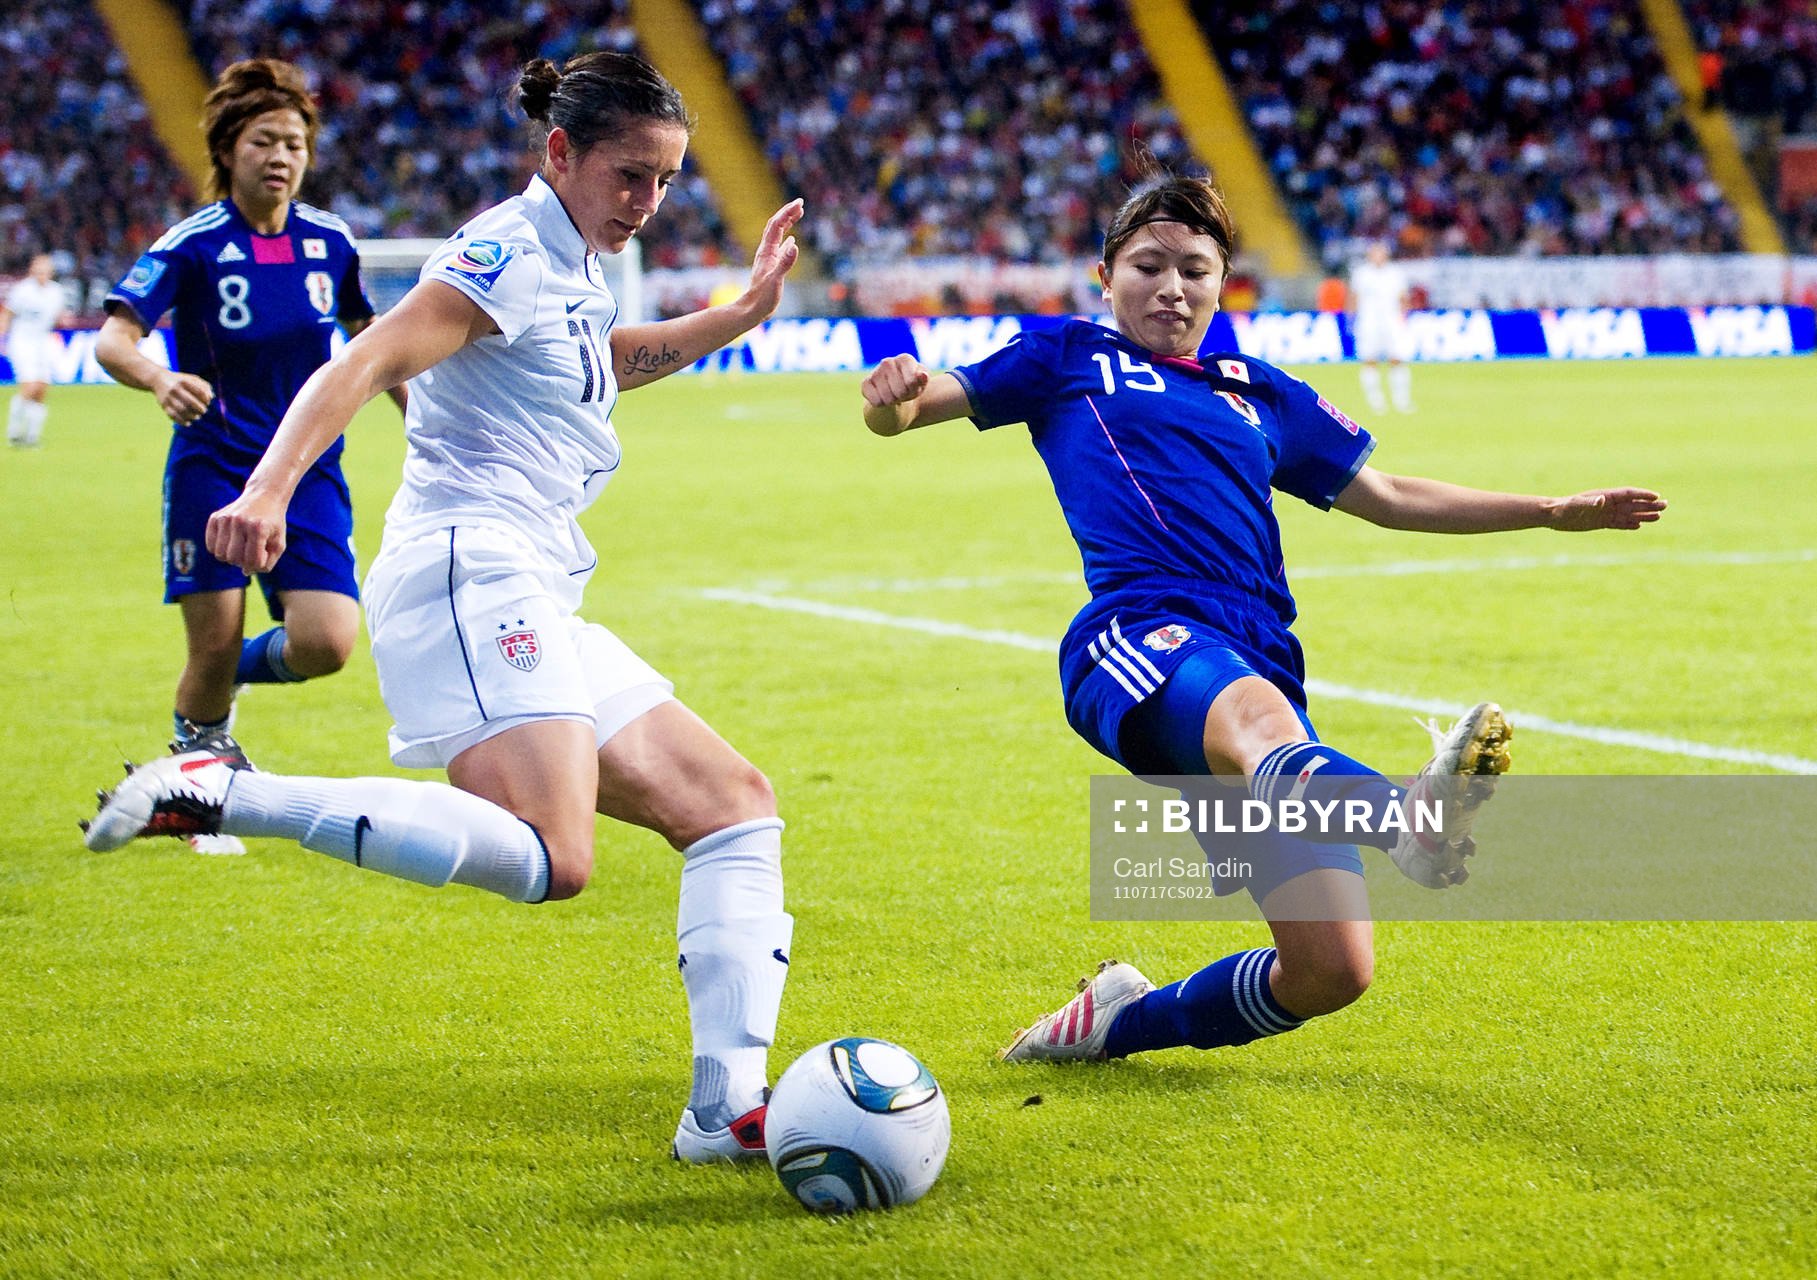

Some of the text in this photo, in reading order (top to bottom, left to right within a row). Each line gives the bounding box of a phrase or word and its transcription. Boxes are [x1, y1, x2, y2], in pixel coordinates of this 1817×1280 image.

[217, 274, 251, 330] 8
[474, 274, 491, 288] FIFA
[750, 317, 863, 371] VISA
[1539, 307, 1647, 359] VISA
[1687, 305, 1794, 357] VISA
[567, 318, 606, 402] 11
[624, 343, 682, 375] Liebe
[1092, 350, 1166, 395] 15
